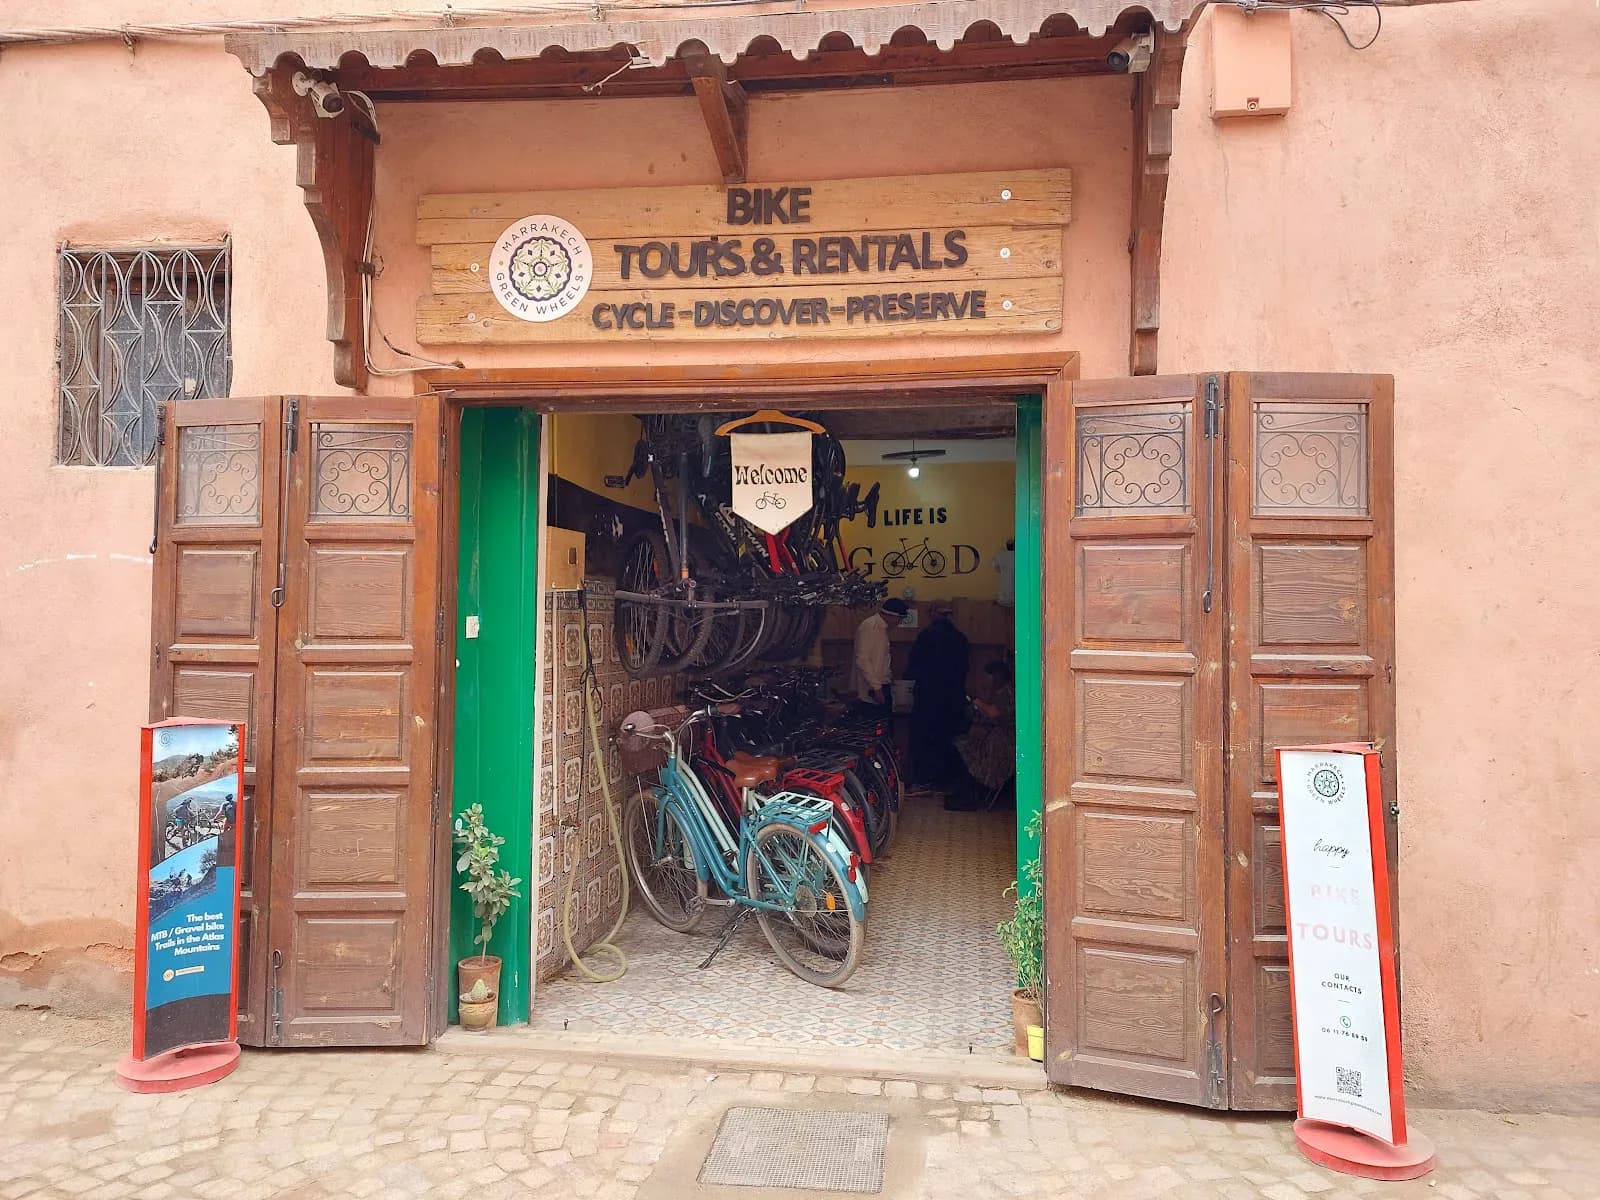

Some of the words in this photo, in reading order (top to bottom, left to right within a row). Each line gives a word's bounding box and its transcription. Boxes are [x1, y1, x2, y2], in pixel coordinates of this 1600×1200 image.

[726, 187, 812, 225] BIKE
[502, 223, 582, 255] MARRAKECH
[613, 239, 746, 279] TOURS
[750, 237, 784, 275] &
[792, 230, 968, 275] RENTALS
[496, 272, 529, 312] GREEN
[535, 275, 583, 314] WHEELS
[735, 463, 807, 485] Welcome
[883, 508, 922, 526] LIFE
[929, 507, 947, 524] IS
[1313, 838, 1351, 859] happy
[186, 913, 203, 922] The
[204, 911, 223, 921] best
[151, 929, 168, 942] MTB
[174, 922, 204, 935] Gravel
[205, 921, 225, 931] bike
[155, 938, 176, 951] Trails
[177, 936, 185, 946] in
[186, 934, 201, 944] the
[201, 932, 225, 942] Atlas
[1296, 923, 1372, 950] TOURS
[174, 942, 221, 956] Mountains
[1334, 972, 1350, 982] OUR
[1321, 981, 1362, 995] CONTACTS
